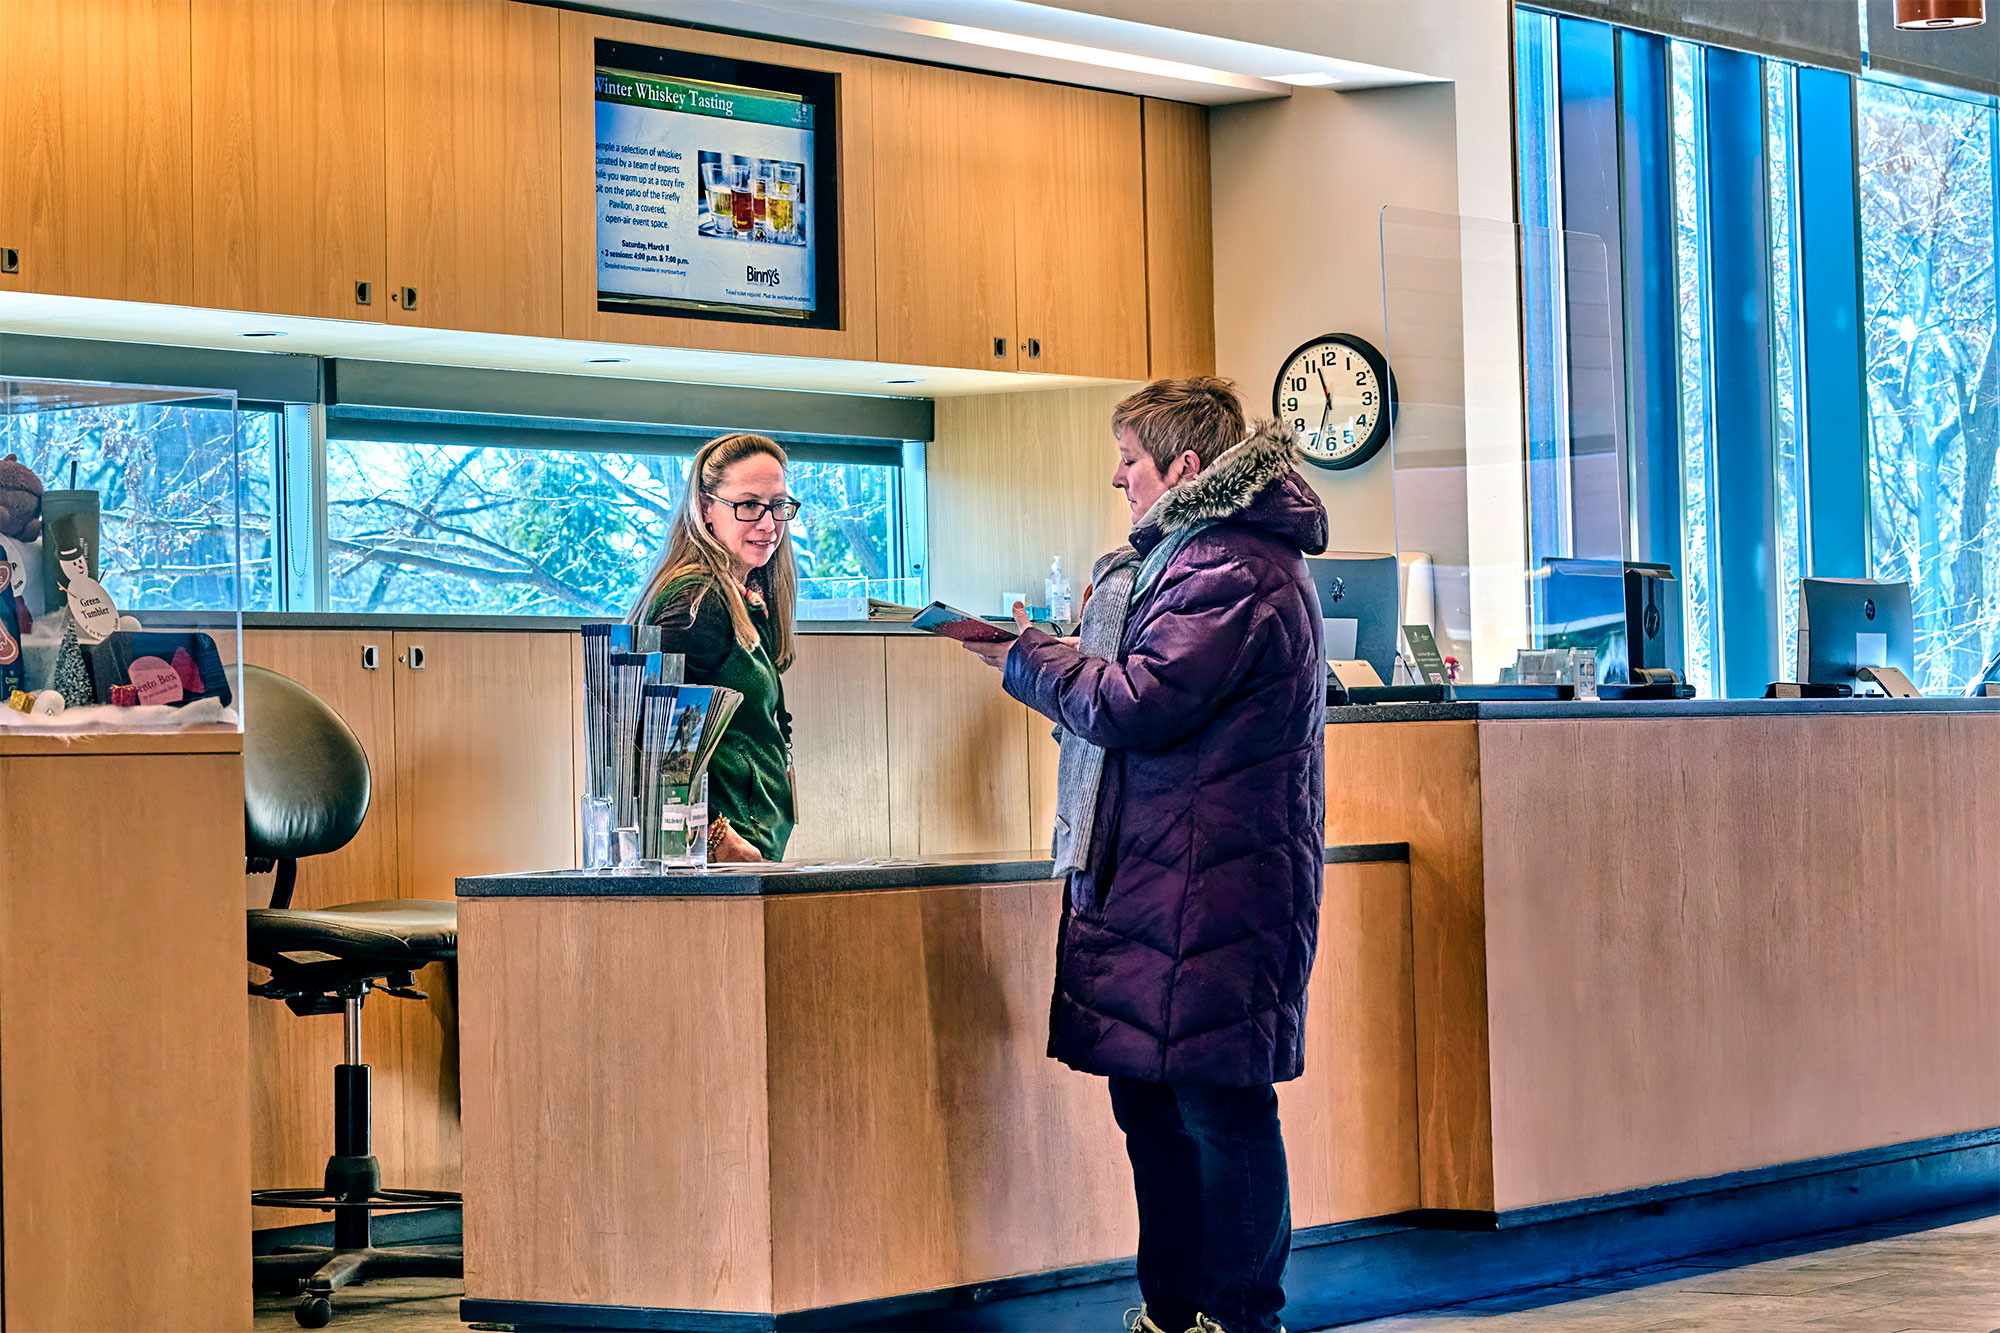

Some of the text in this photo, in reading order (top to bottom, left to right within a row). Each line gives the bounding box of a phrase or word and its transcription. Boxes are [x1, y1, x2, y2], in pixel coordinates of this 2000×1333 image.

[595, 76, 733, 116] Winter Whiskey Tasting
[621, 145, 648, 155] selection
[649, 147, 656, 156] of
[657, 149, 682, 160] whiskies
[619, 158, 627, 168] by
[633, 161, 648, 170] team
[650, 162, 657, 171] of
[658, 165, 680, 174] experts
[607, 173, 619, 181] you
[639, 176, 647, 185] up
[648, 177, 654, 185] at
[660, 179, 673, 188] cozy
[675, 178, 685, 188] fire
[604, 186, 613, 194] on
[614, 186, 624, 195] the
[626, 188, 641, 197] patio
[642, 189, 649, 198] of
[650, 191, 660, 199] the
[662, 192, 680, 203] Firefly
[609, 200, 634, 211] Pavilion,
[641, 205, 666, 215] covered,
[605, 215, 669, 228] open-air event space.
[622, 240, 647, 251] Saturday,
[648, 242, 664, 251] March
[610, 251, 633, 259] sessions:
[747, 265, 780, 287] Binny's
[1321, 352, 1336, 366] 12
[1346, 357, 1350, 370] 1
[1305, 360, 1316, 374] 11
[1291, 377, 1307, 391] 10
[1356, 372, 1367, 386] 2
[1287, 398, 1298, 411] 9
[1362, 392, 1372, 405] 3
[1294, 418, 1305, 432] 8
[1356, 414, 1367, 427] 4
[1308, 432, 1318, 446] 7
[1326, 437, 1337, 451] 6
[1343, 430, 1354, 444] 5
[80, 598, 100, 607] Green
[81, 607, 110, 619] Tumbler
[157, 673, 177, 685] Box
